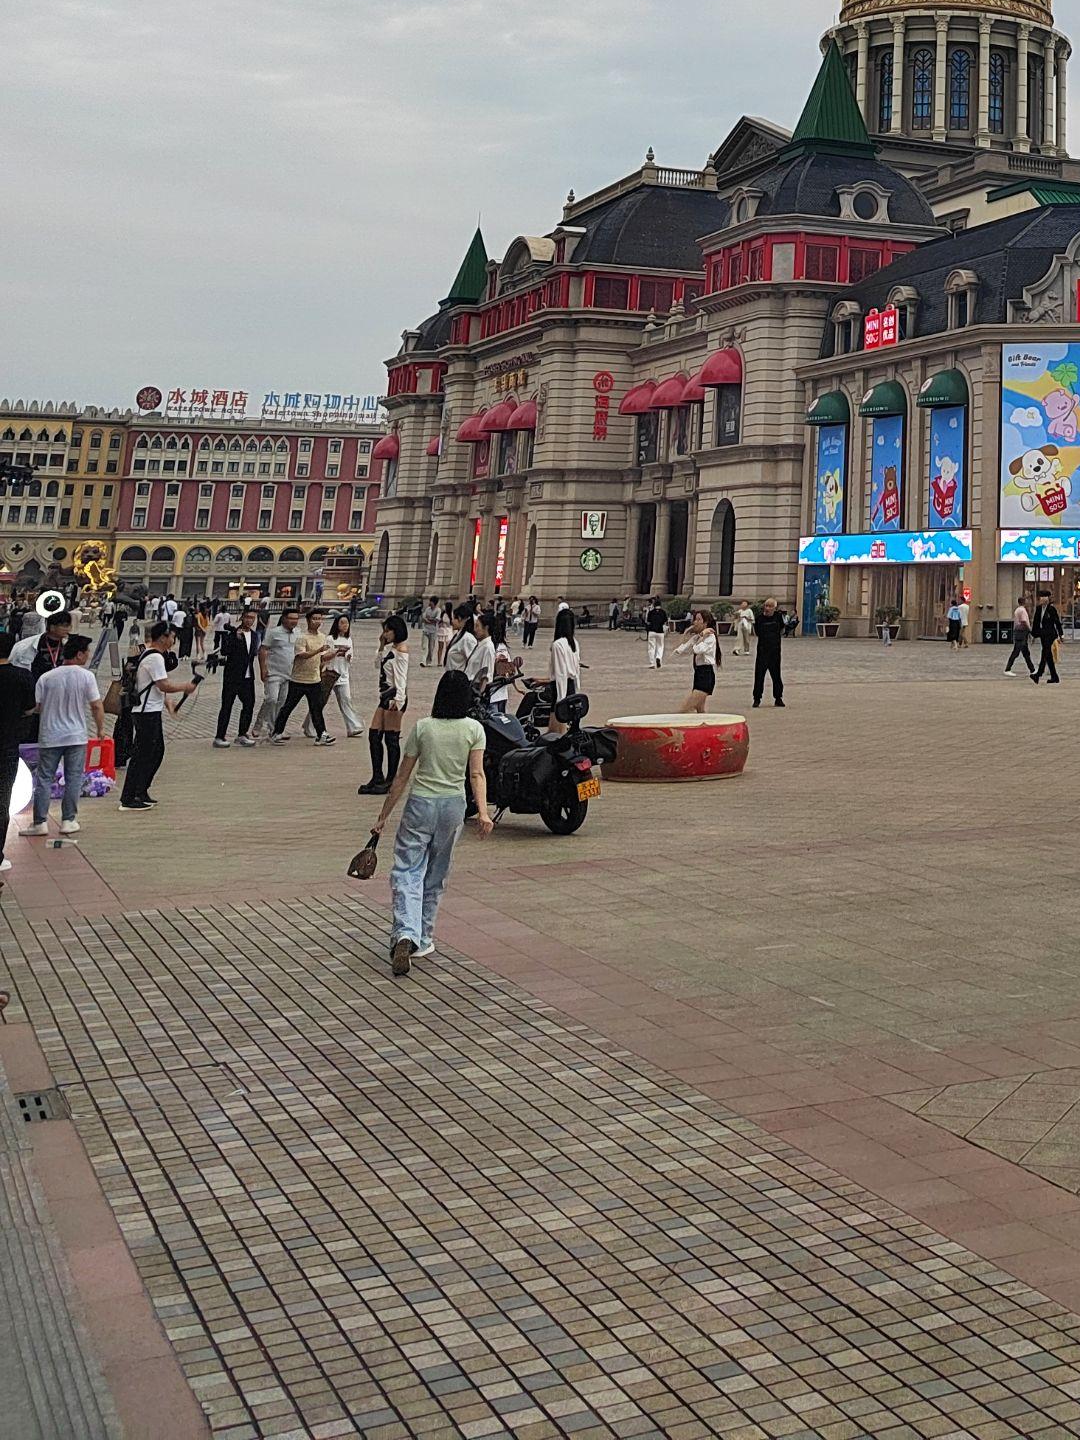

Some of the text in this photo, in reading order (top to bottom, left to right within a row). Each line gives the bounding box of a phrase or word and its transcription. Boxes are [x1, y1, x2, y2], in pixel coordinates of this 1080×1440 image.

[866, 319, 879, 330] MINI
[1023, 354, 1042, 362] Bear
[168, 387, 249, 408] 水城酒店
[263, 390, 379, 411] 水城购物中心
[1045, 493, 1063, 506] MINI
